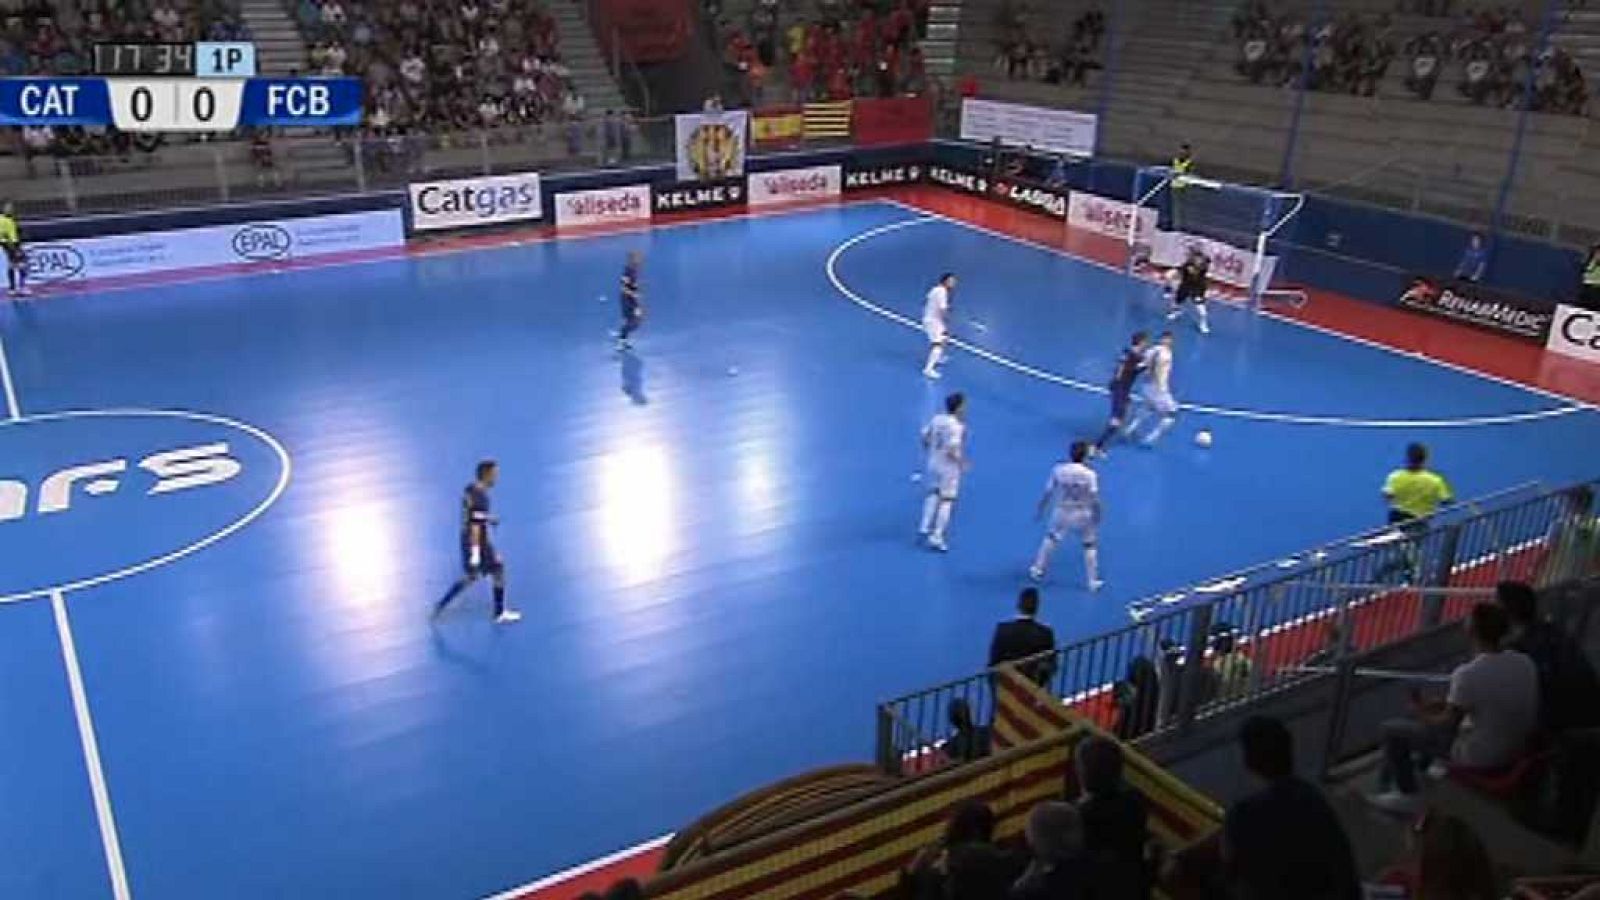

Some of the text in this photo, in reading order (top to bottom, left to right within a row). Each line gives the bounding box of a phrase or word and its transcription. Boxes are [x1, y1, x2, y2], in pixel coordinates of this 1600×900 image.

[846, 167, 905, 187] KELME
[417, 182, 535, 218] Catgas
[655, 185, 724, 209] KELME
[240, 230, 281, 252] EPAL
[27, 251, 75, 275] EPAL
